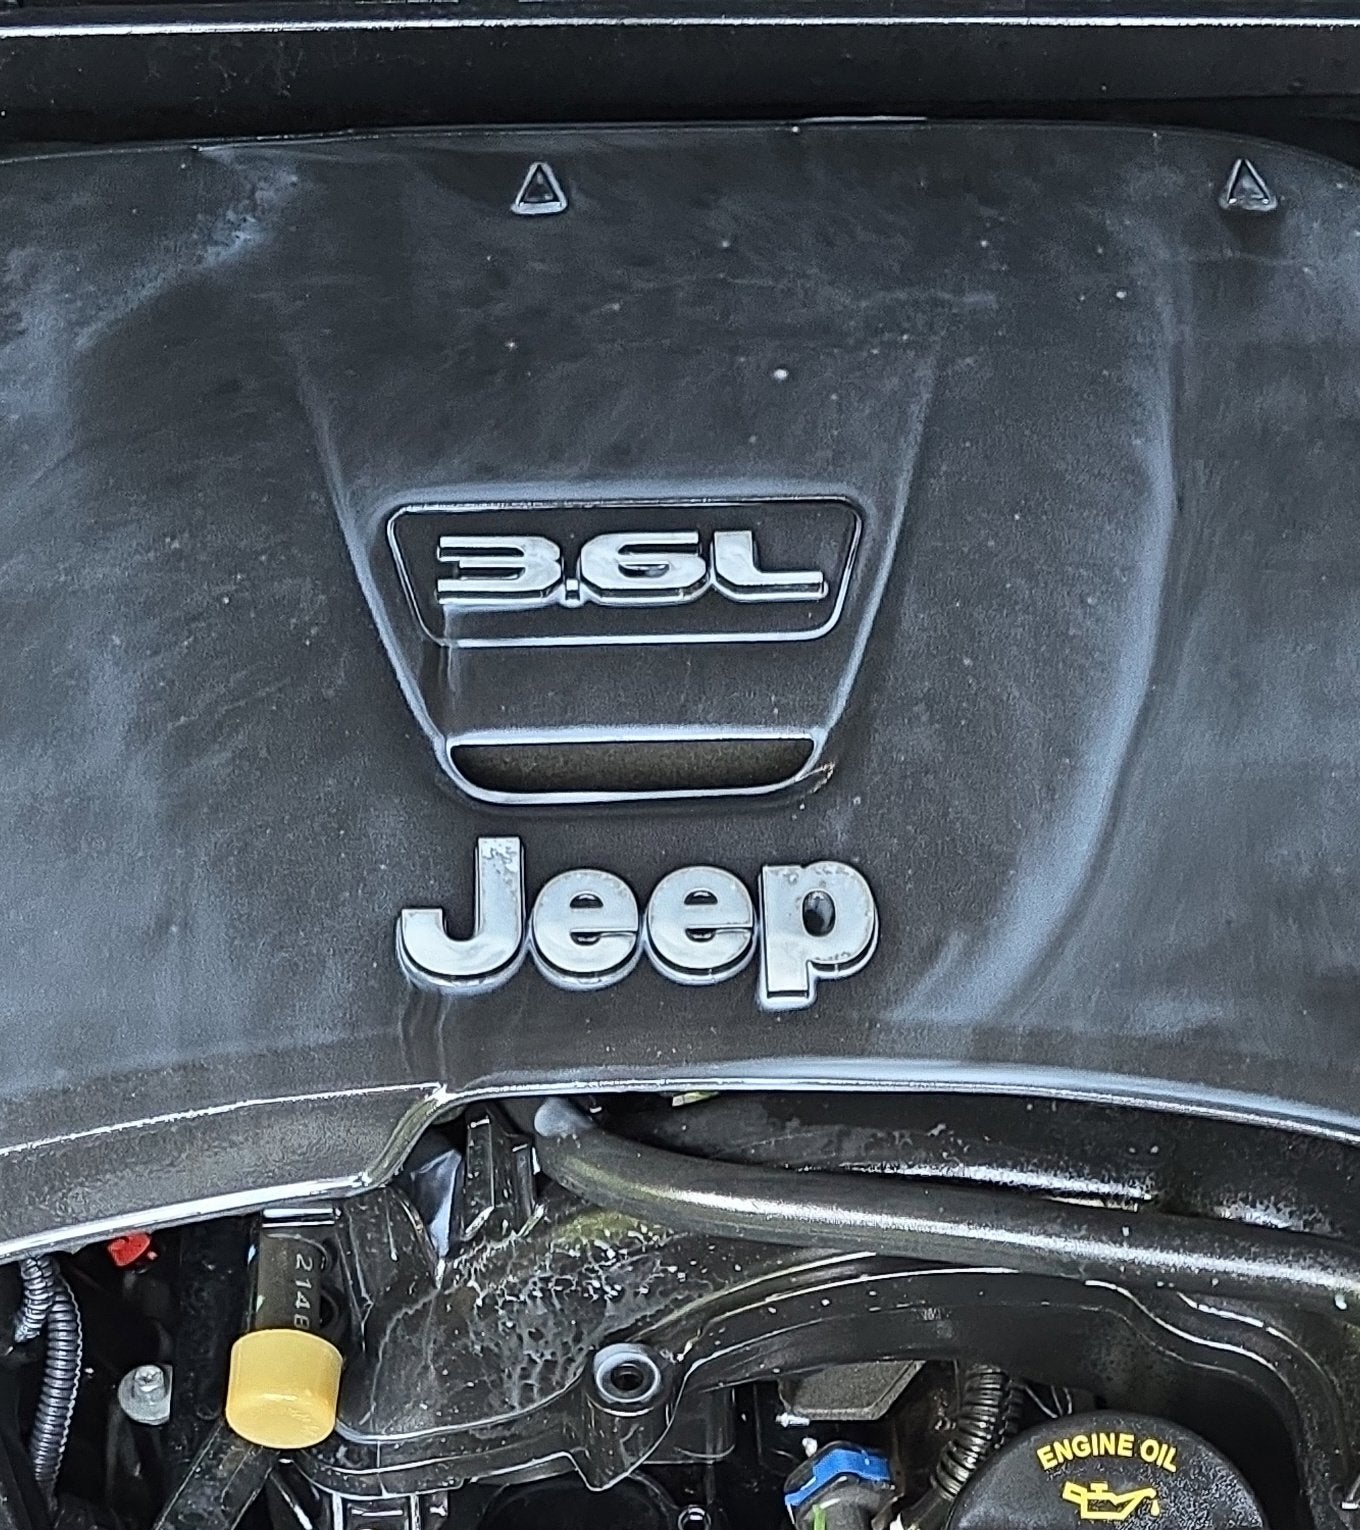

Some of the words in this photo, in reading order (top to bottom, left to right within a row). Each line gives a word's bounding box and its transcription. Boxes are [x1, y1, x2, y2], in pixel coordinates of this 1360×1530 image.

[436, 530, 829, 608] 3.6L
[396, 836, 880, 1011] Jeep
[1036, 1432, 1136, 1471] ENGINE
[1140, 1438, 1178, 1473] OIL
